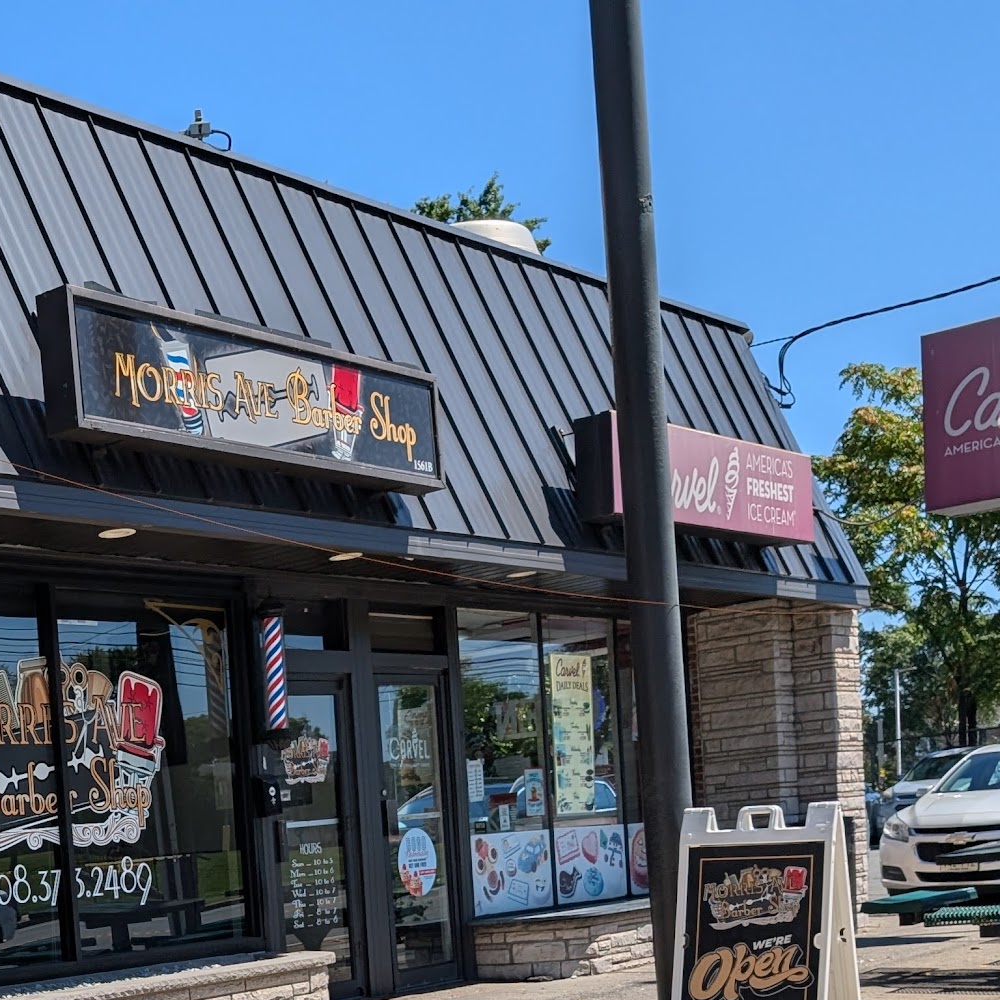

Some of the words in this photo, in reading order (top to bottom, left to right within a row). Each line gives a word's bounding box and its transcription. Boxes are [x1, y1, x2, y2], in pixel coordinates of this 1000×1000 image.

[286, 366, 363, 435] Barber
[369, 391, 417, 462] Shop
[413, 459, 434, 472] 1561B
[746, 452, 793, 479] AMERICA'S
[671, 456, 719, 513] rvel
[746, 477, 794, 503] FRESHEST
[747, 503, 762, 522] ICE
[764, 506, 795, 526] CREAM
[556, 658, 580, 677] Carvel
[556, 681, 571, 692] DAILY
[573, 681, 588, 692] DEALS
[89, 758, 150, 829] Shop
[299, 842, 322, 855] HOURS
[720, 900, 762, 919] Barber
[753, 934, 792, 950] WE'RE
